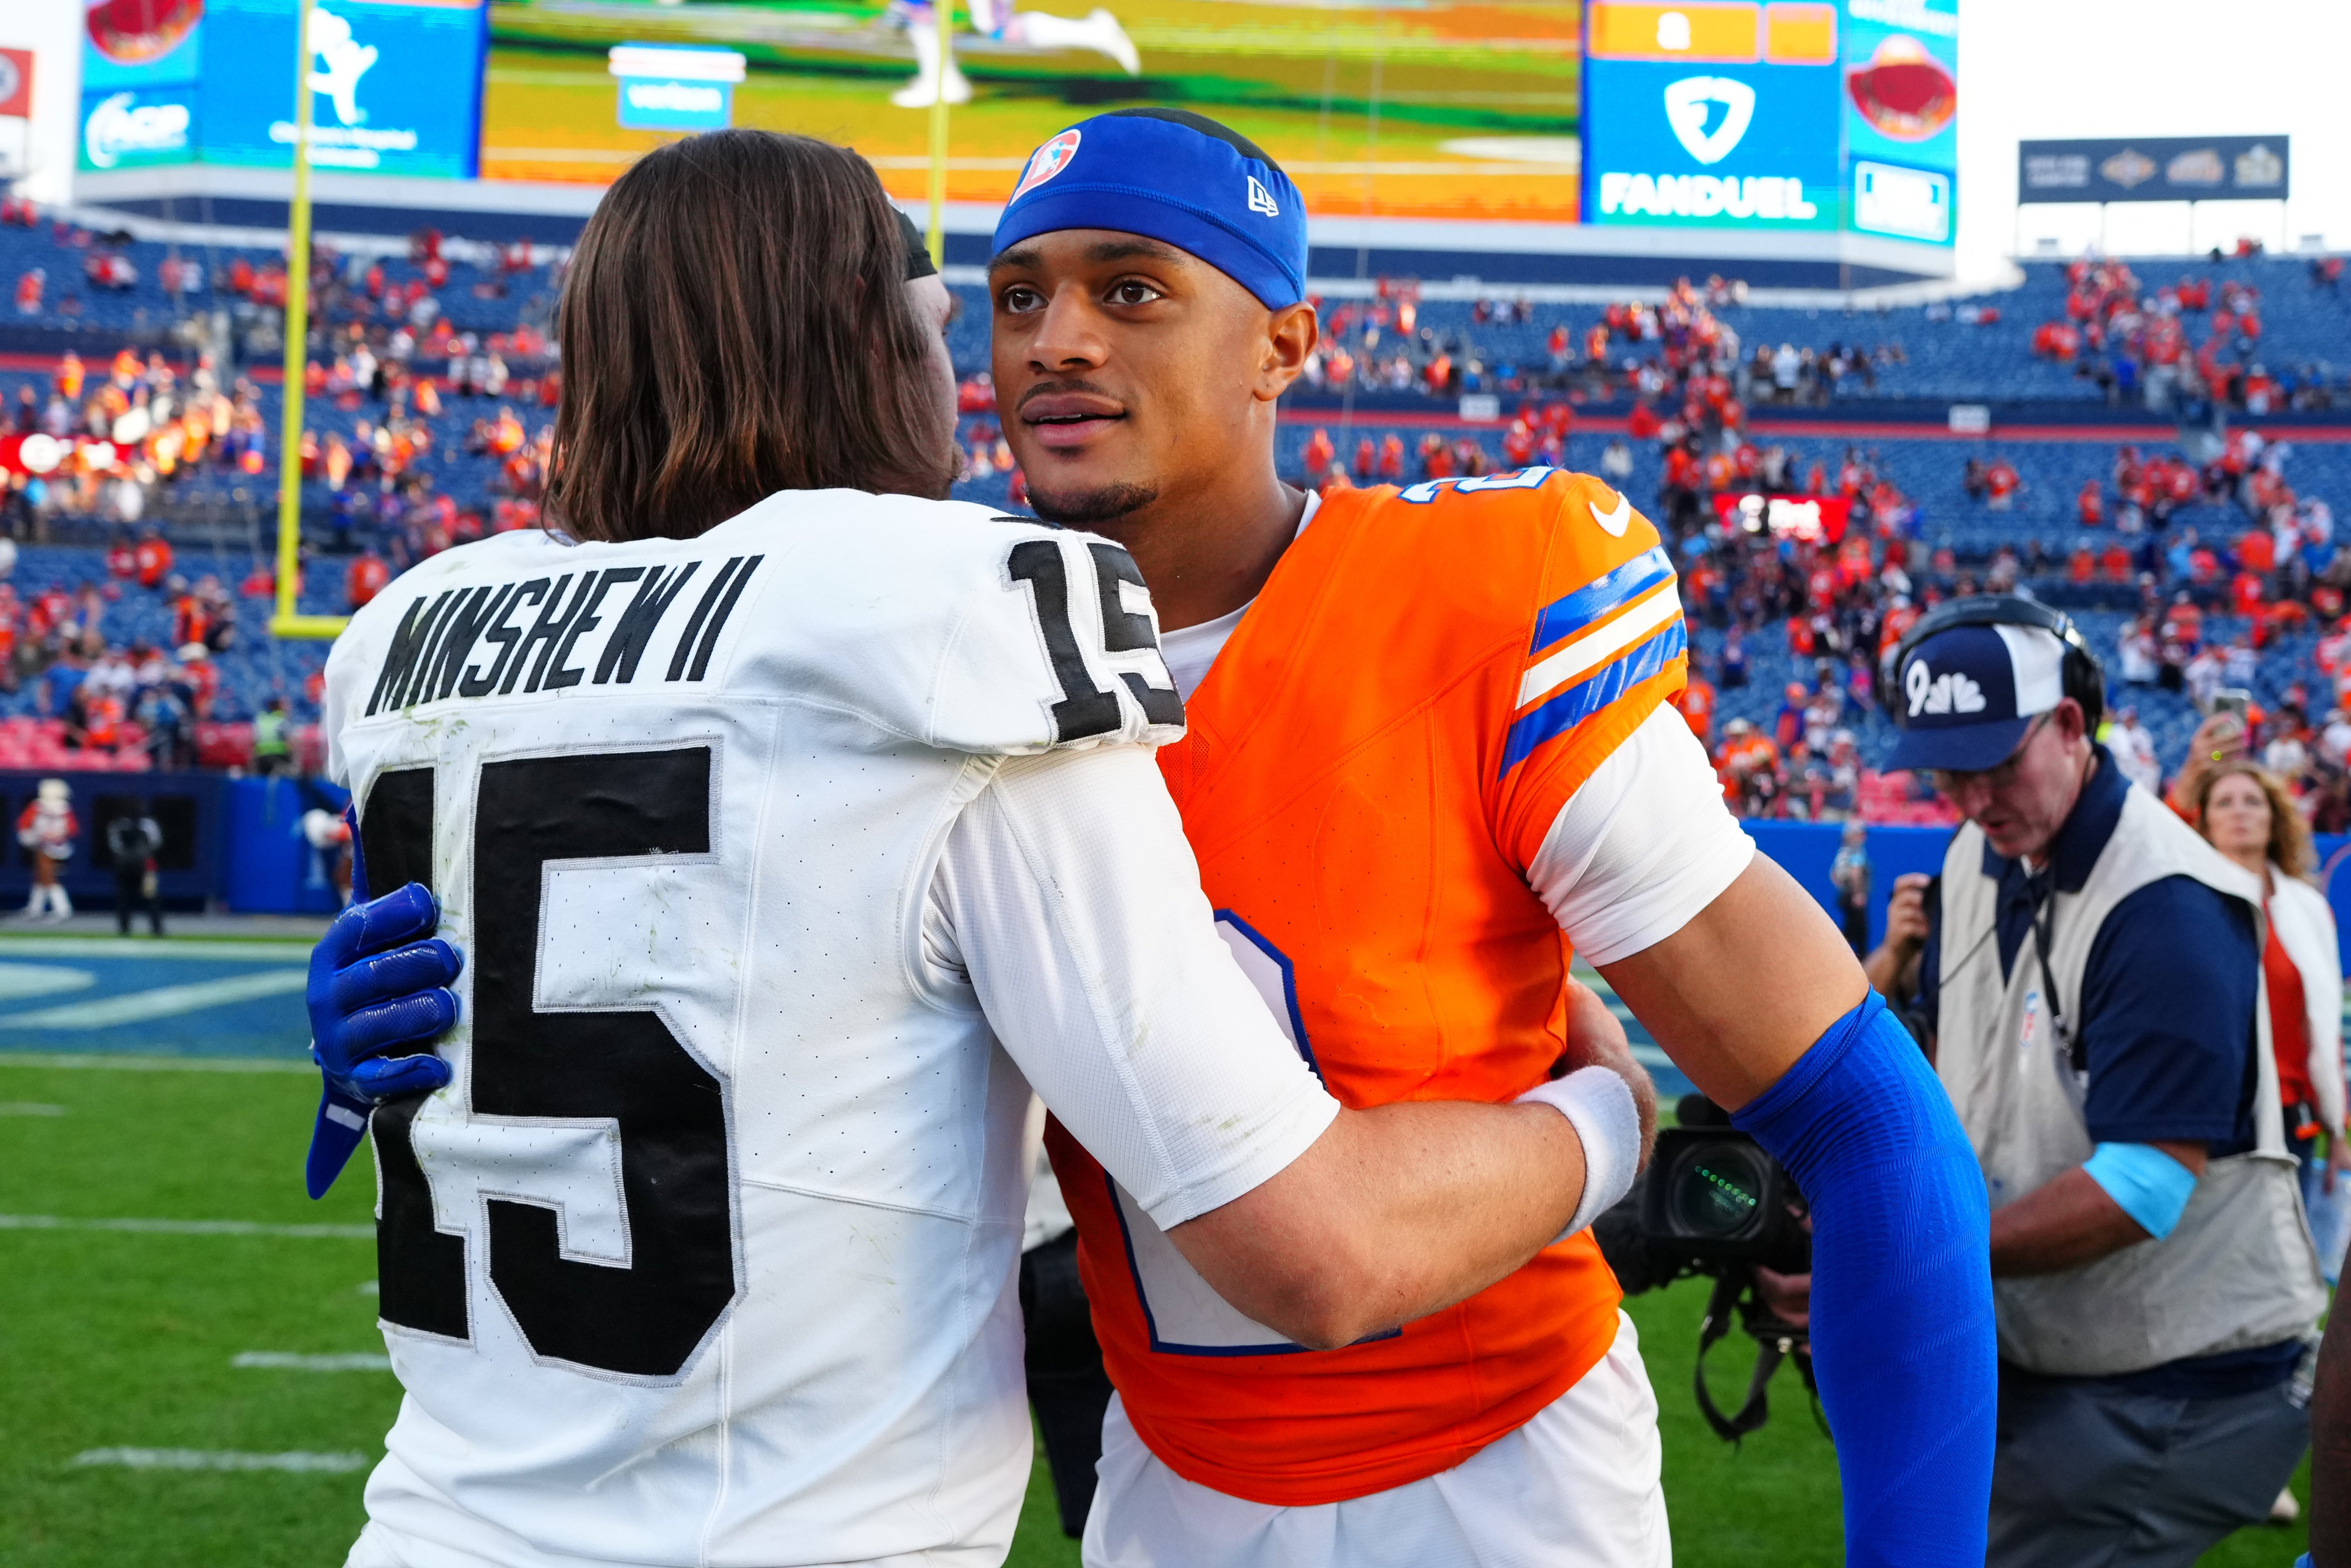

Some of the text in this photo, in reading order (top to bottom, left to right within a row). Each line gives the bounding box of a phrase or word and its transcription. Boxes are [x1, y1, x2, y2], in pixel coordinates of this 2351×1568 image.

[1600, 172, 1817, 219] FANDUEL
[365, 554, 765, 717] MINSHEW II
[999, 535, 1187, 749] 15
[357, 735, 747, 1387] 15
